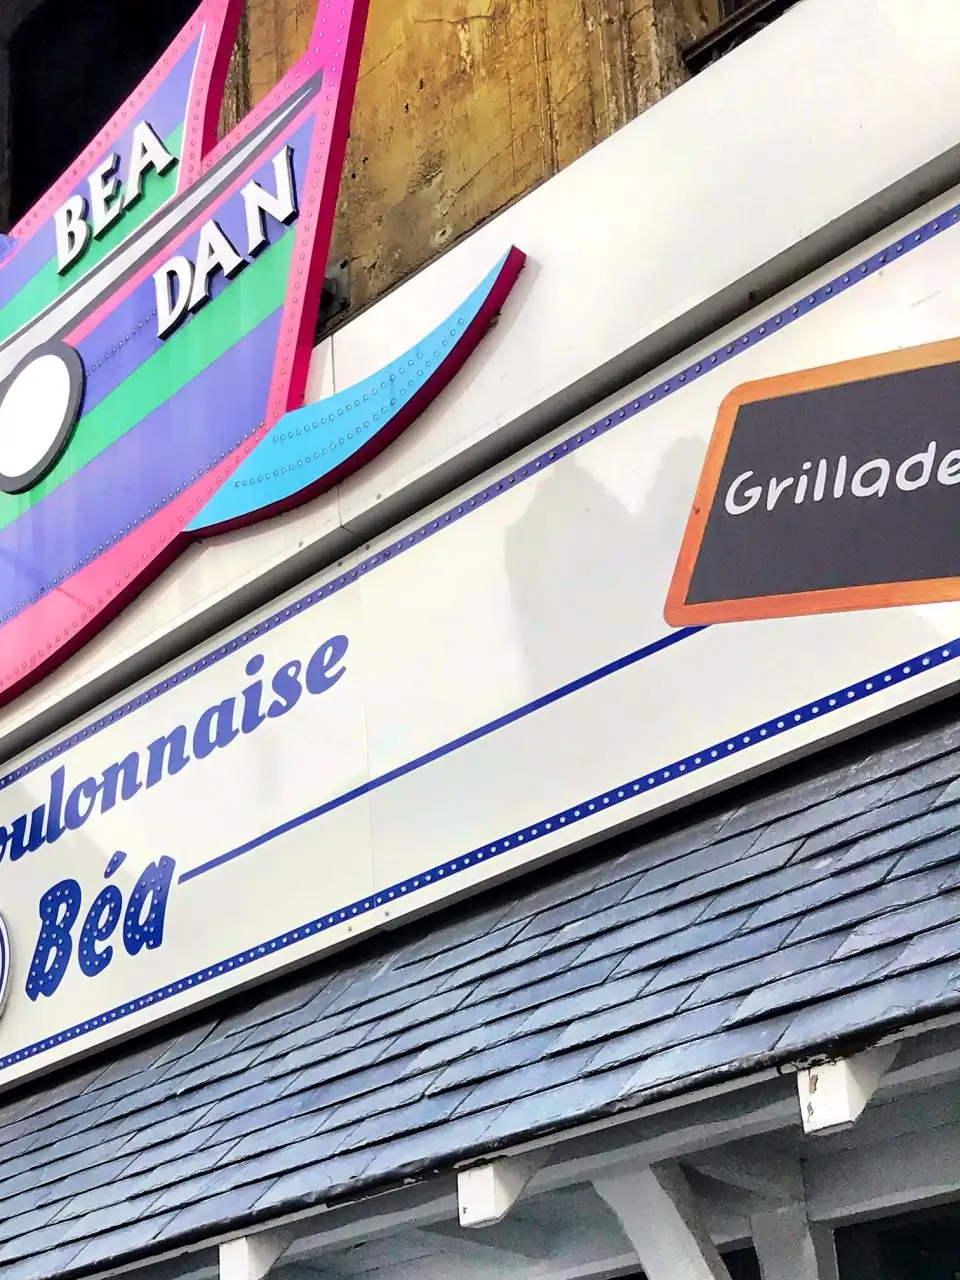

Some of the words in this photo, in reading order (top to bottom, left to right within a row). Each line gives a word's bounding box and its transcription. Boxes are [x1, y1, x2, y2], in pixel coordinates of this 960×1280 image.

[54, 120, 179, 277] BEA
[153, 145, 299, 341] DAN
[24, 850, 177, 1002] Béa
